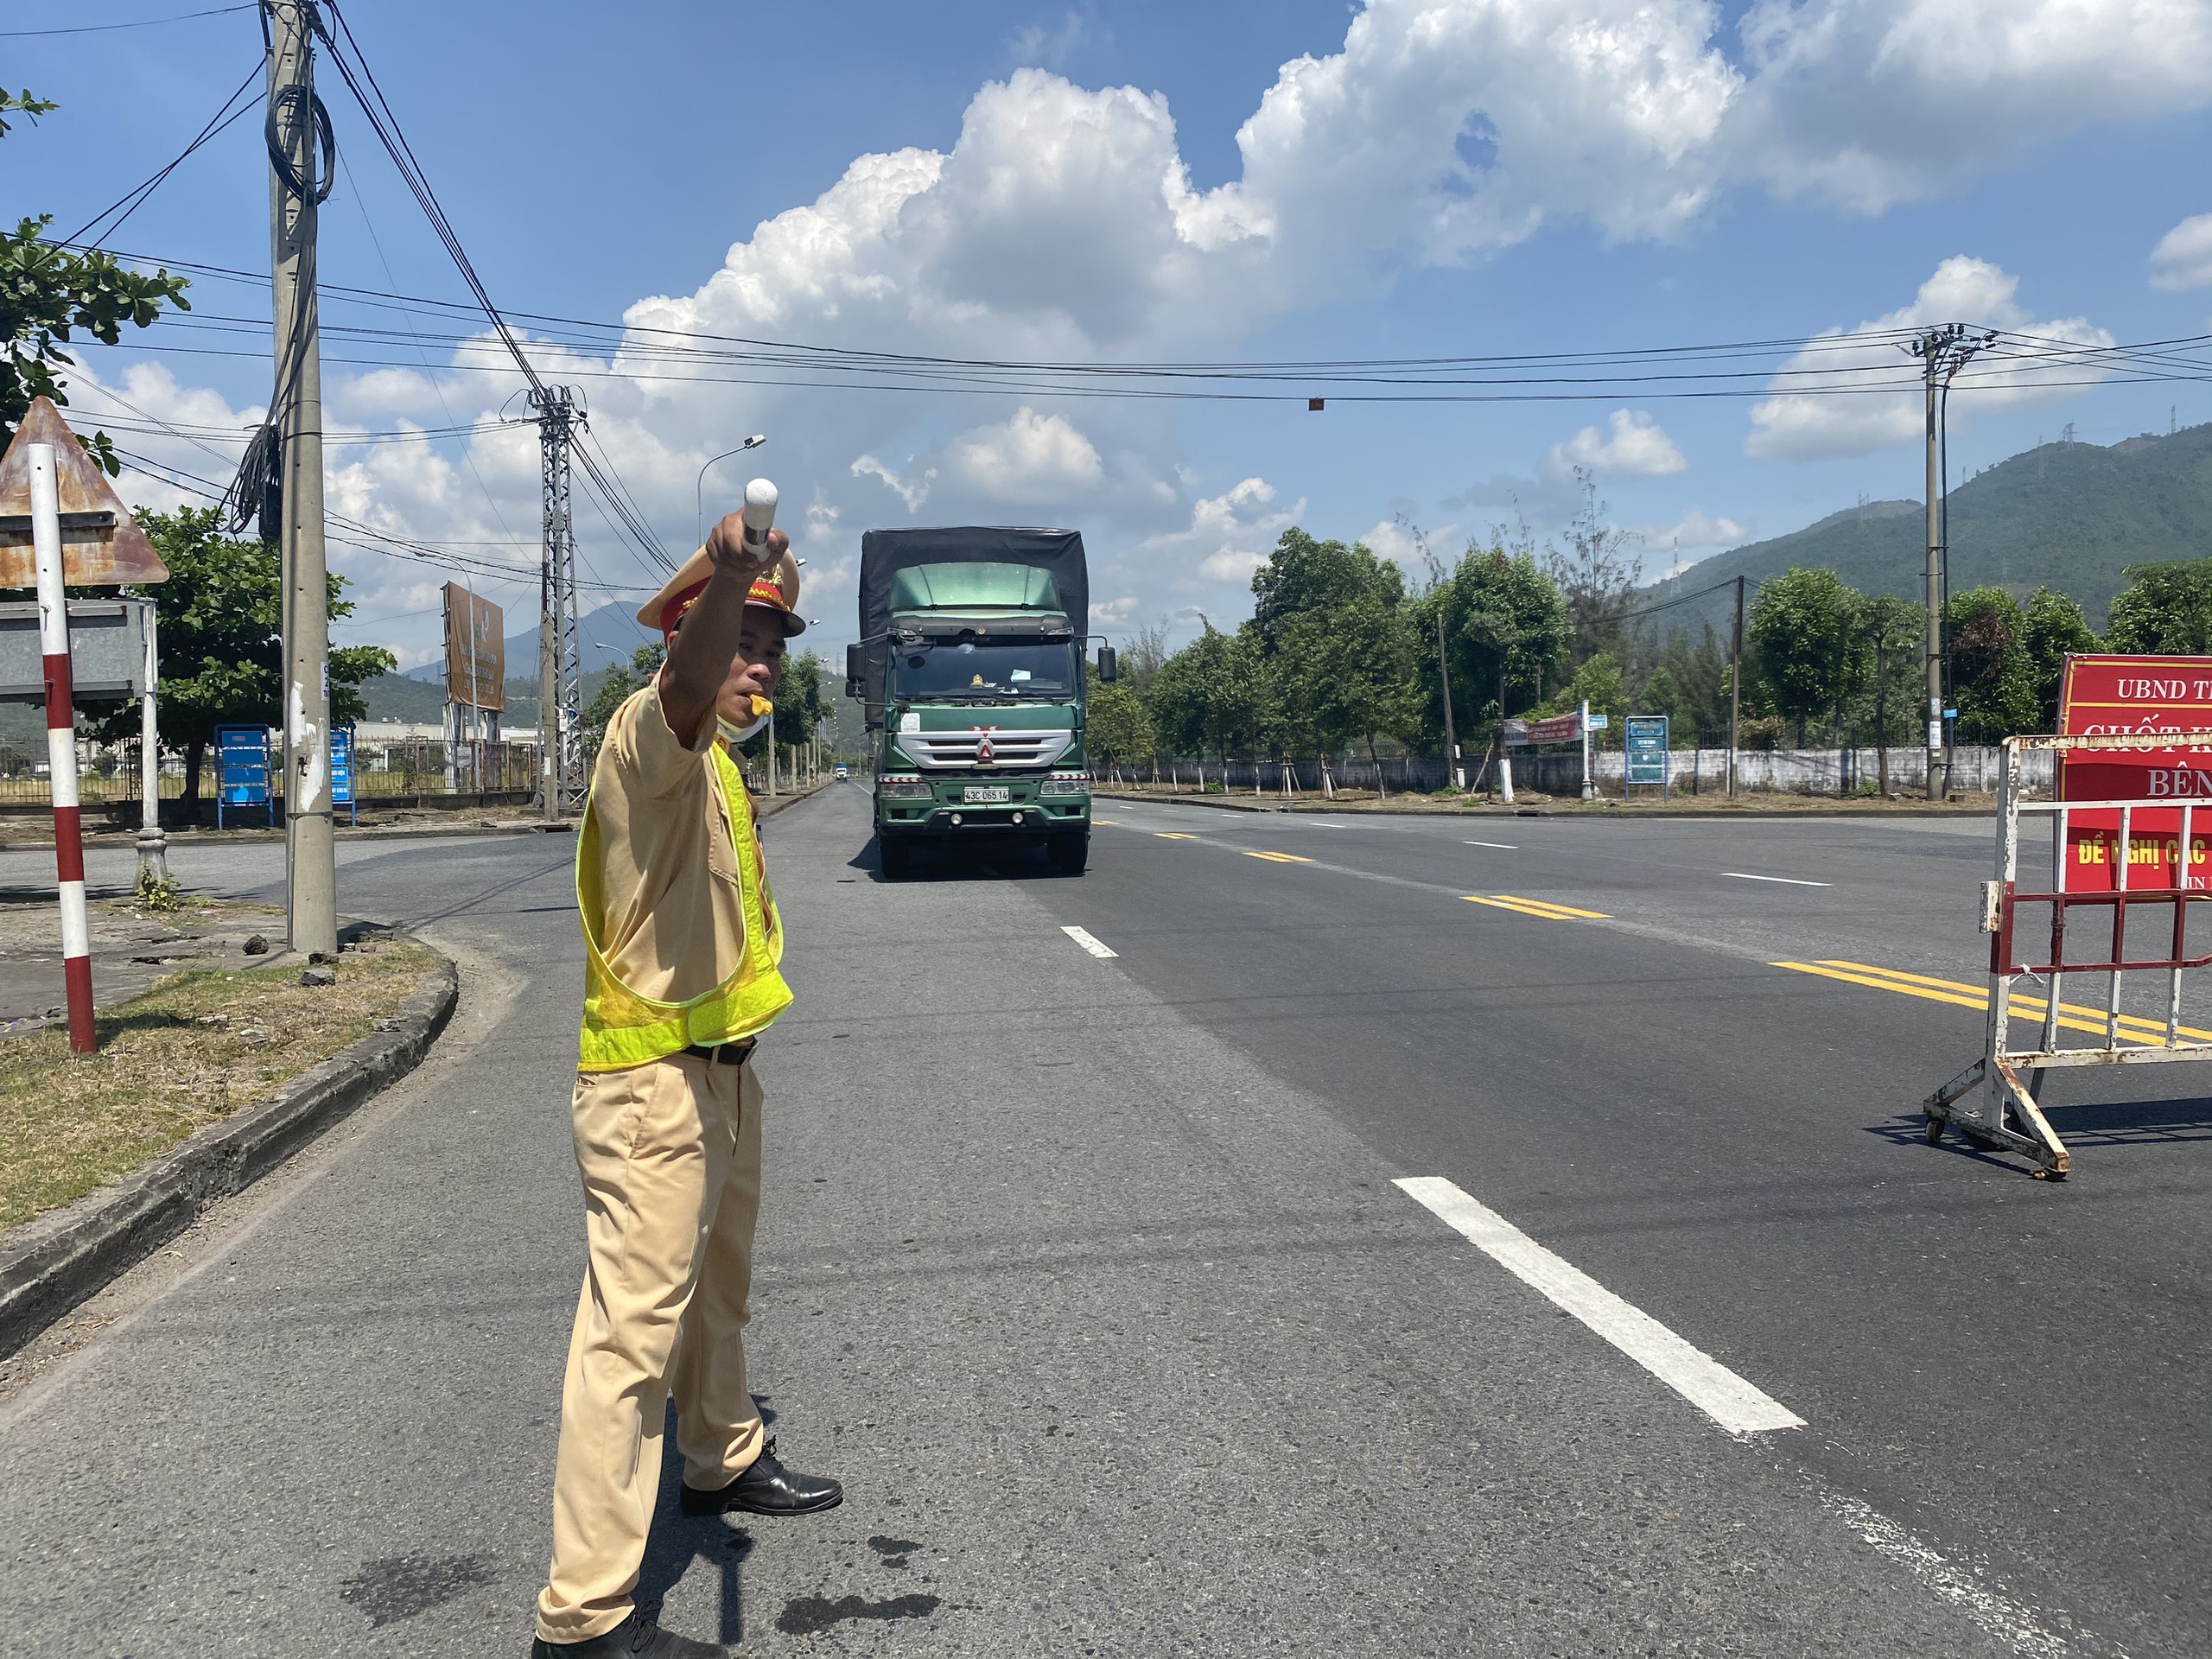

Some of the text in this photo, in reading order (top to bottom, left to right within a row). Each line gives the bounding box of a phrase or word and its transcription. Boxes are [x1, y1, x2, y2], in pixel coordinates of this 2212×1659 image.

[2117, 678, 2212, 700] UBND T
[965, 791, 981, 800] 43C
[2078, 830, 2105, 864] ĐỀ
